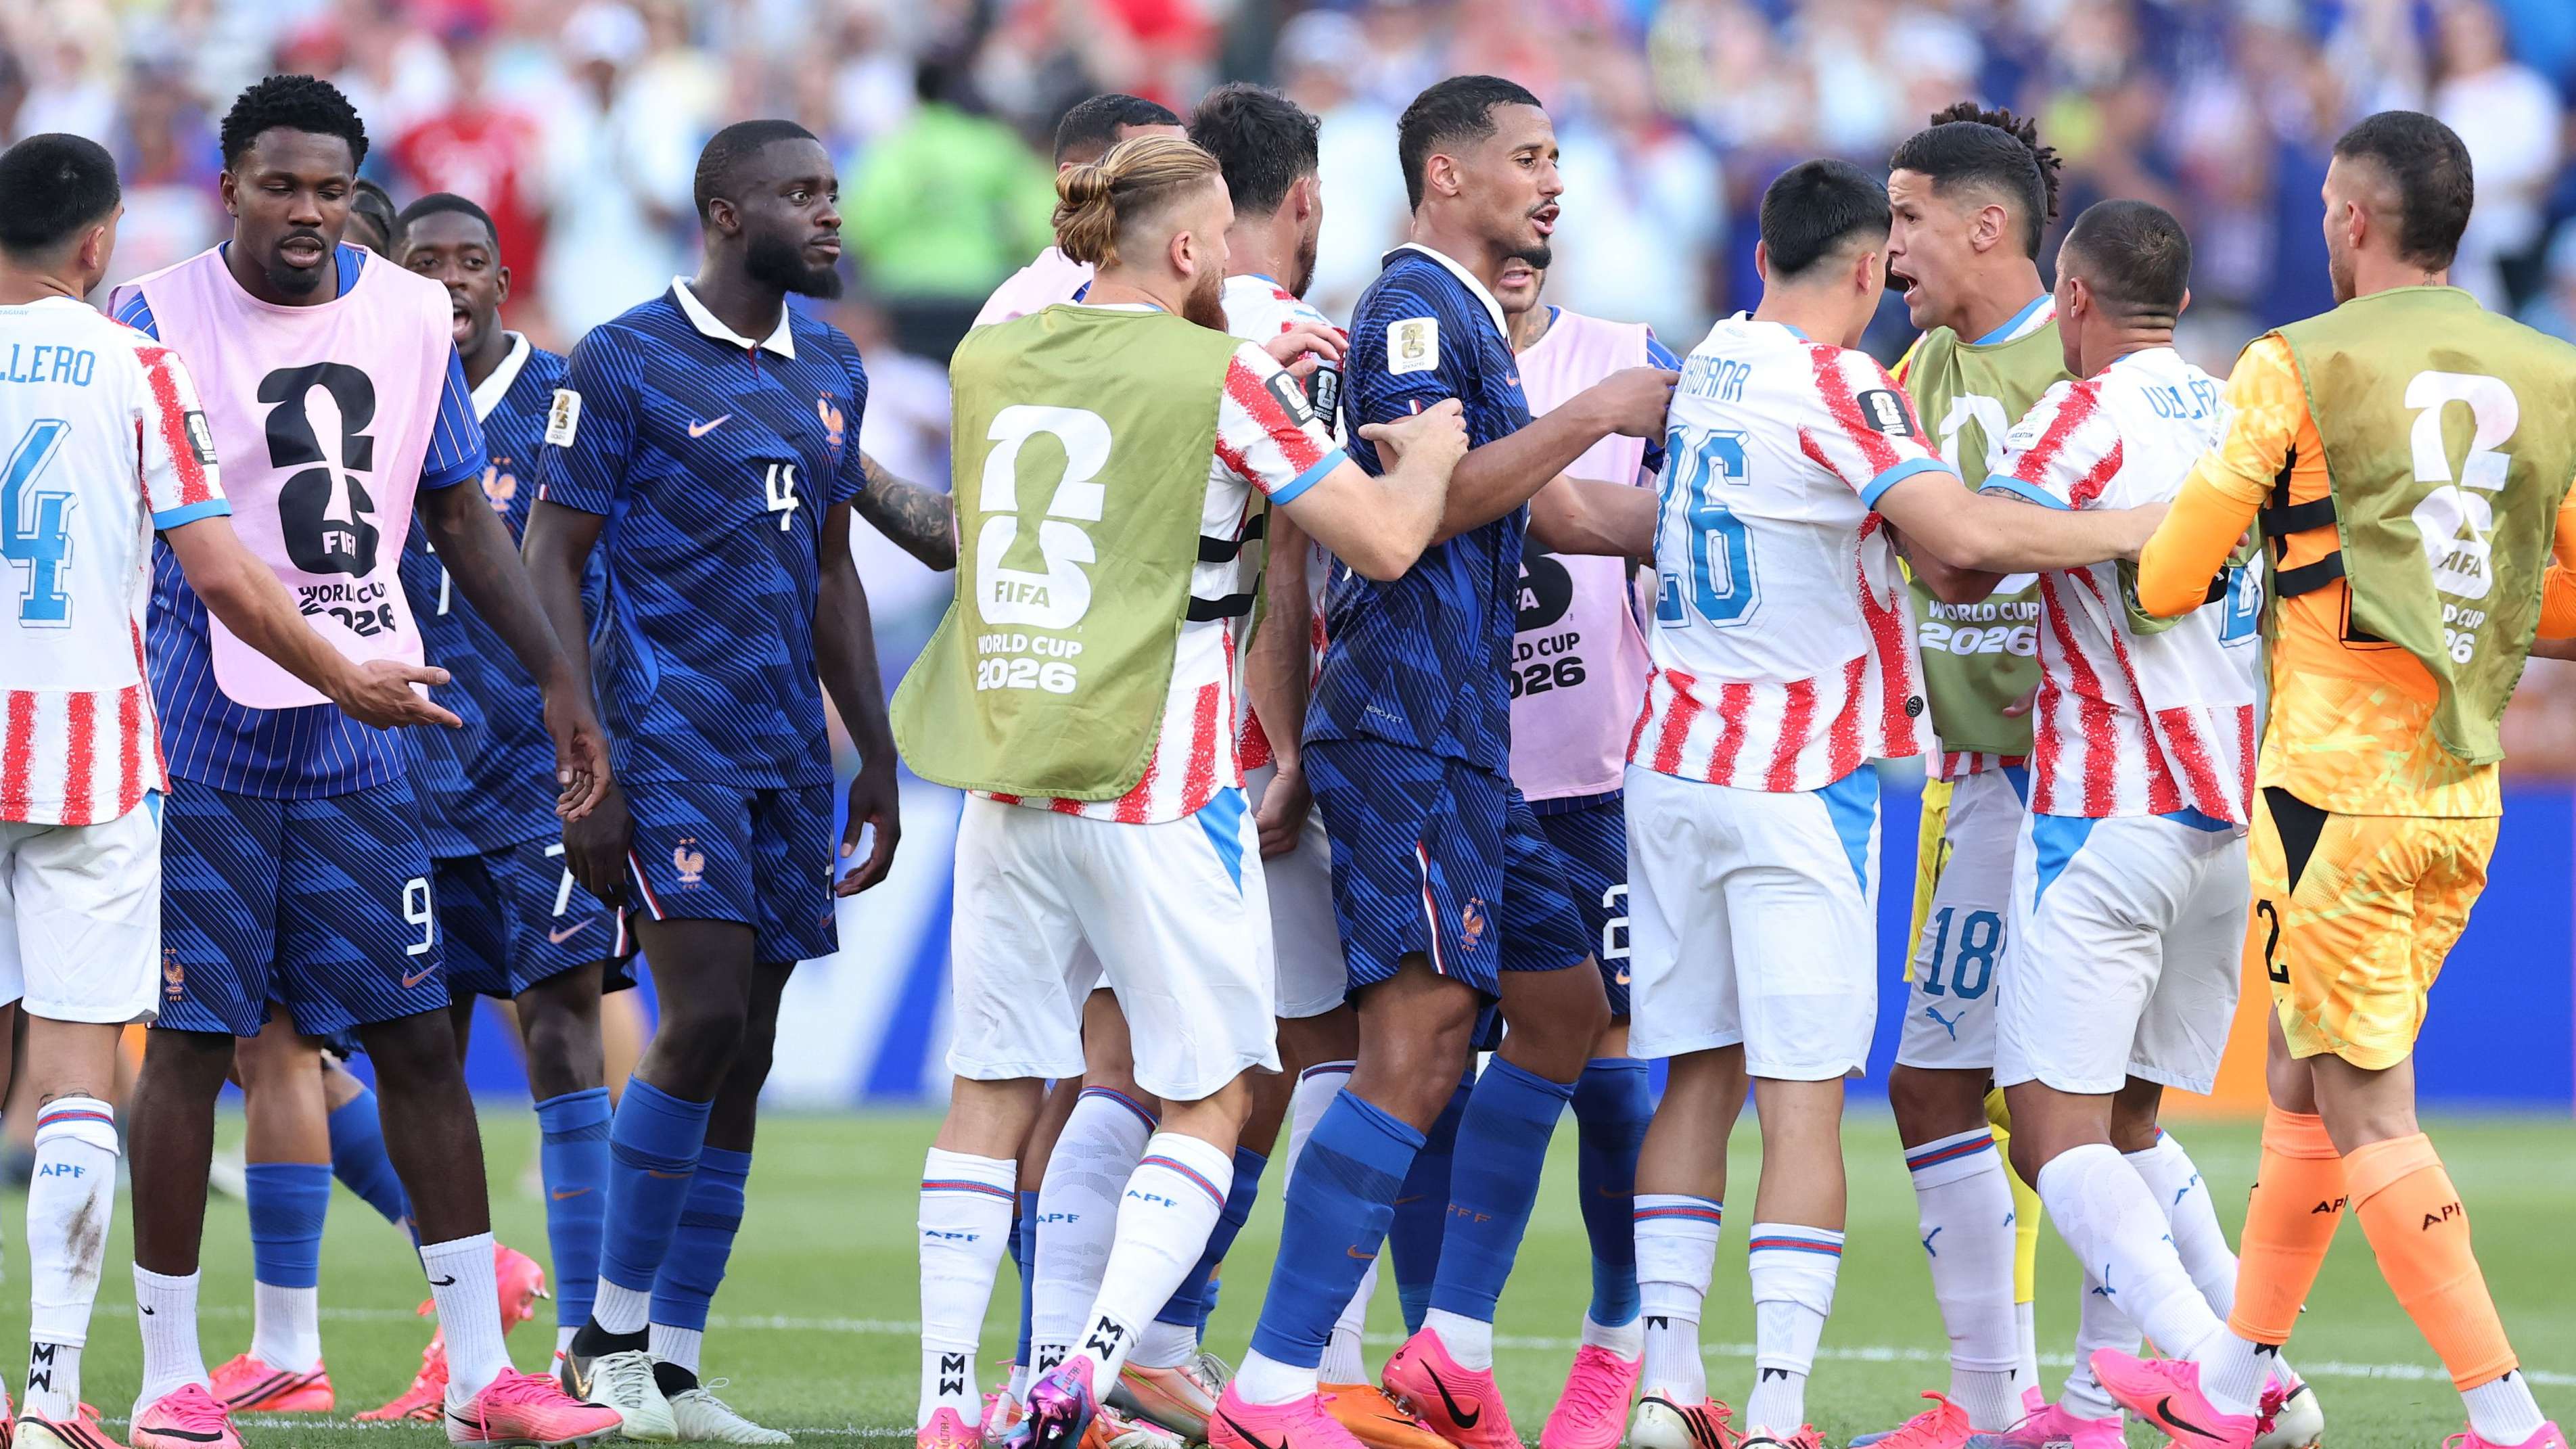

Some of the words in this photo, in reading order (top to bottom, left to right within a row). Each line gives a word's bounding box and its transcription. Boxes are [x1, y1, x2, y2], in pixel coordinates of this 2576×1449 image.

[0, 344, 96, 387] LERO
[766, 464, 800, 531] 4
[0, 419, 78, 628] 4
[298, 584, 356, 603] WORL
[357, 581, 388, 603] CU
[995, 581, 1051, 608] FIFA
[1929, 600, 1996, 622] WORLD
[2000, 602, 2040, 621] CUP
[2457, 609, 2485, 629] CUP
[978, 634, 1028, 655] WORLD
[1032, 636, 1082, 659] CUP
[1538, 632, 1580, 656] CUP
[1918, 622, 2037, 657] 2026
[977, 658, 1077, 694] 2026
[402, 877, 433, 956] 9
[1923, 907, 2002, 1000] 18
[2257, 899, 2291, 984] 2
[39, 1163, 86, 1178] APF
[1126, 1189, 1178, 1208] APF
[1036, 1213, 1080, 1224] APF
[925, 1230, 980, 1242] APF
